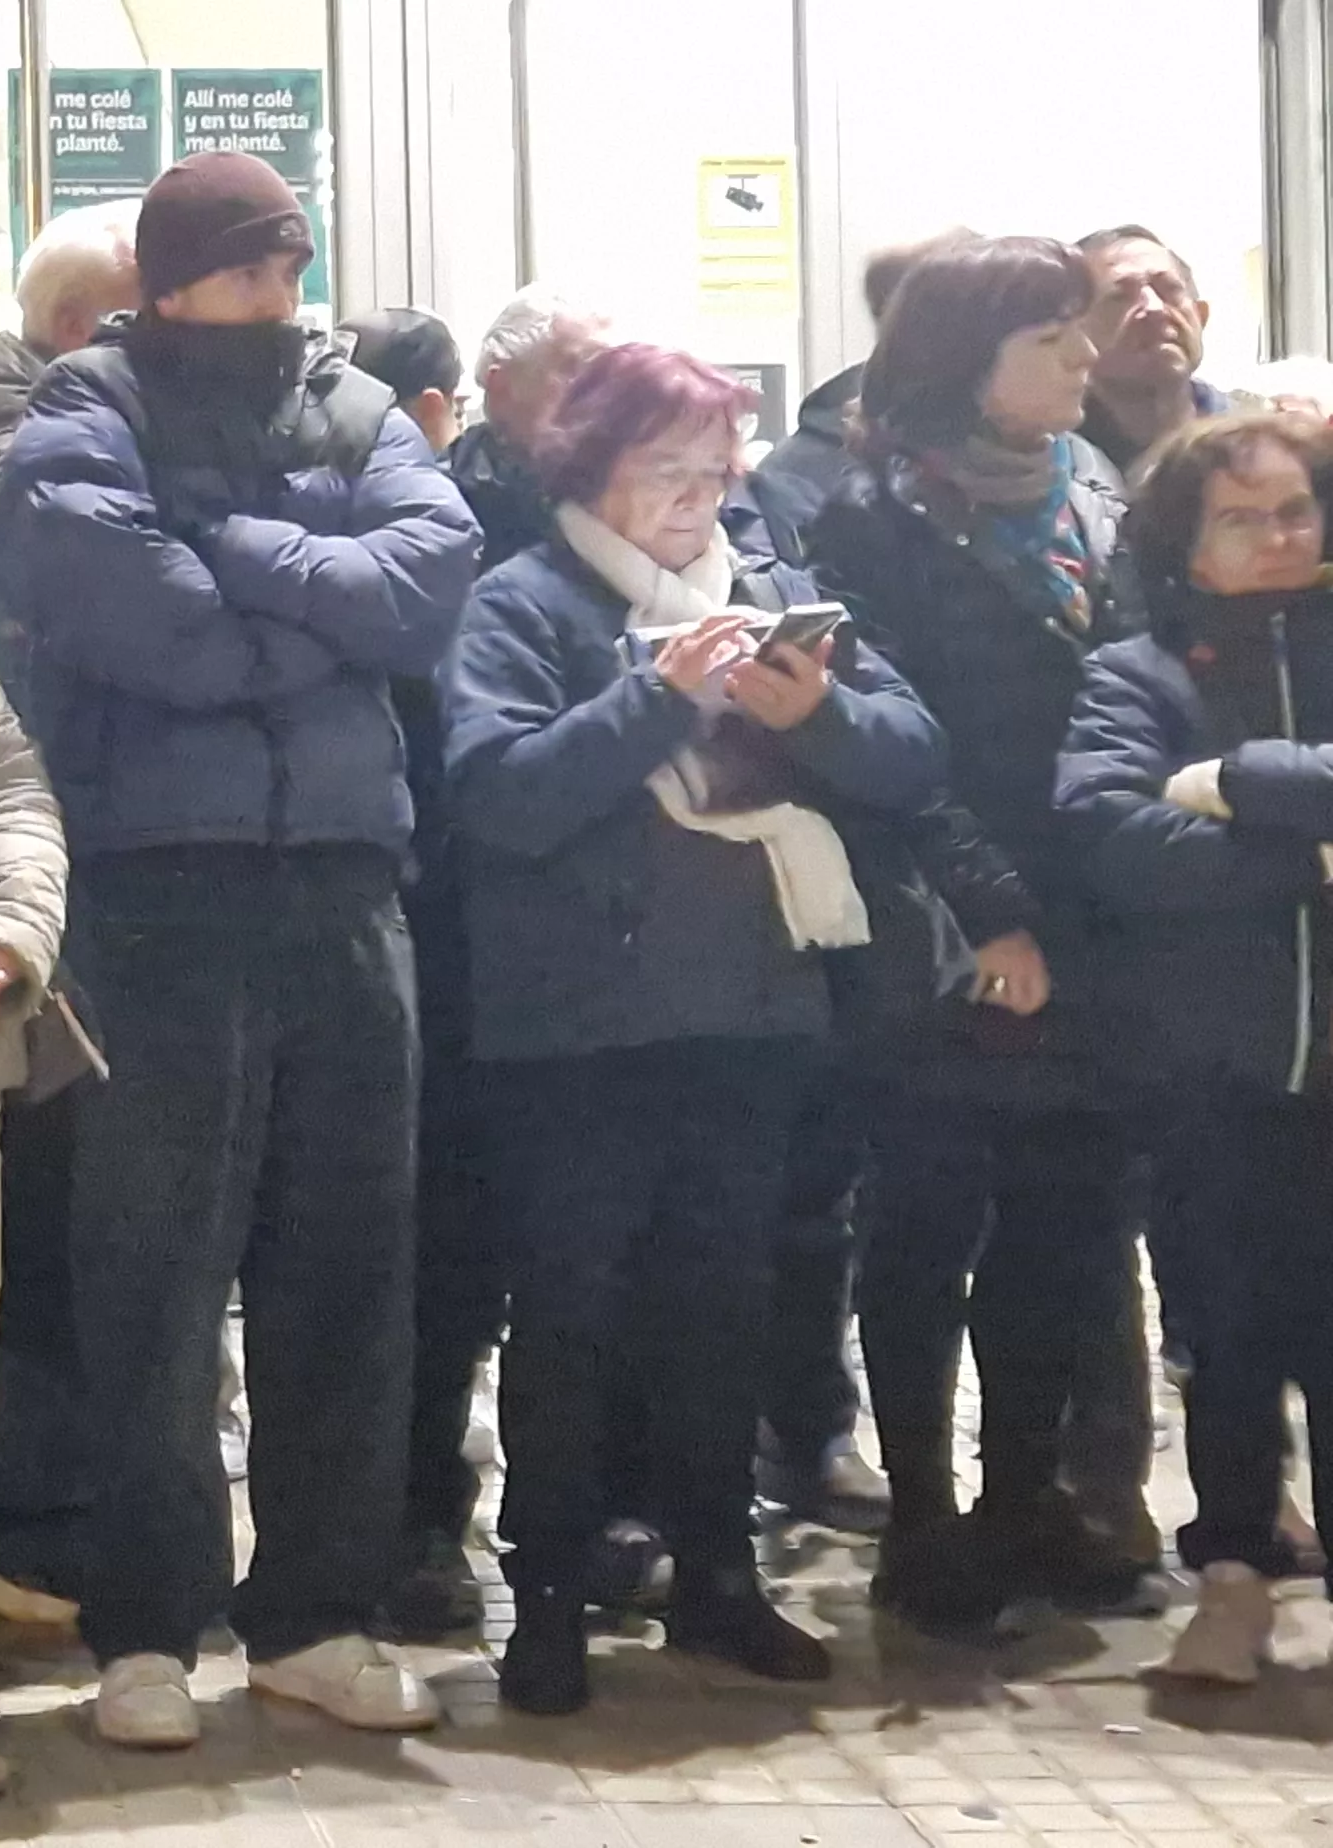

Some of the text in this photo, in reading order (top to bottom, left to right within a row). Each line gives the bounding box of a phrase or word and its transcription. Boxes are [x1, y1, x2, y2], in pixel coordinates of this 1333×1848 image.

[55, 88, 132, 109] me colé
[184, 87, 293, 109] Allí me colé
[66, 113, 87, 130] tu
[91, 111, 148, 130] fiesta
[184, 111, 309, 132] y en tu fiesta
[56, 132, 125, 156] planté.
[186, 131, 287, 152] me planté.
